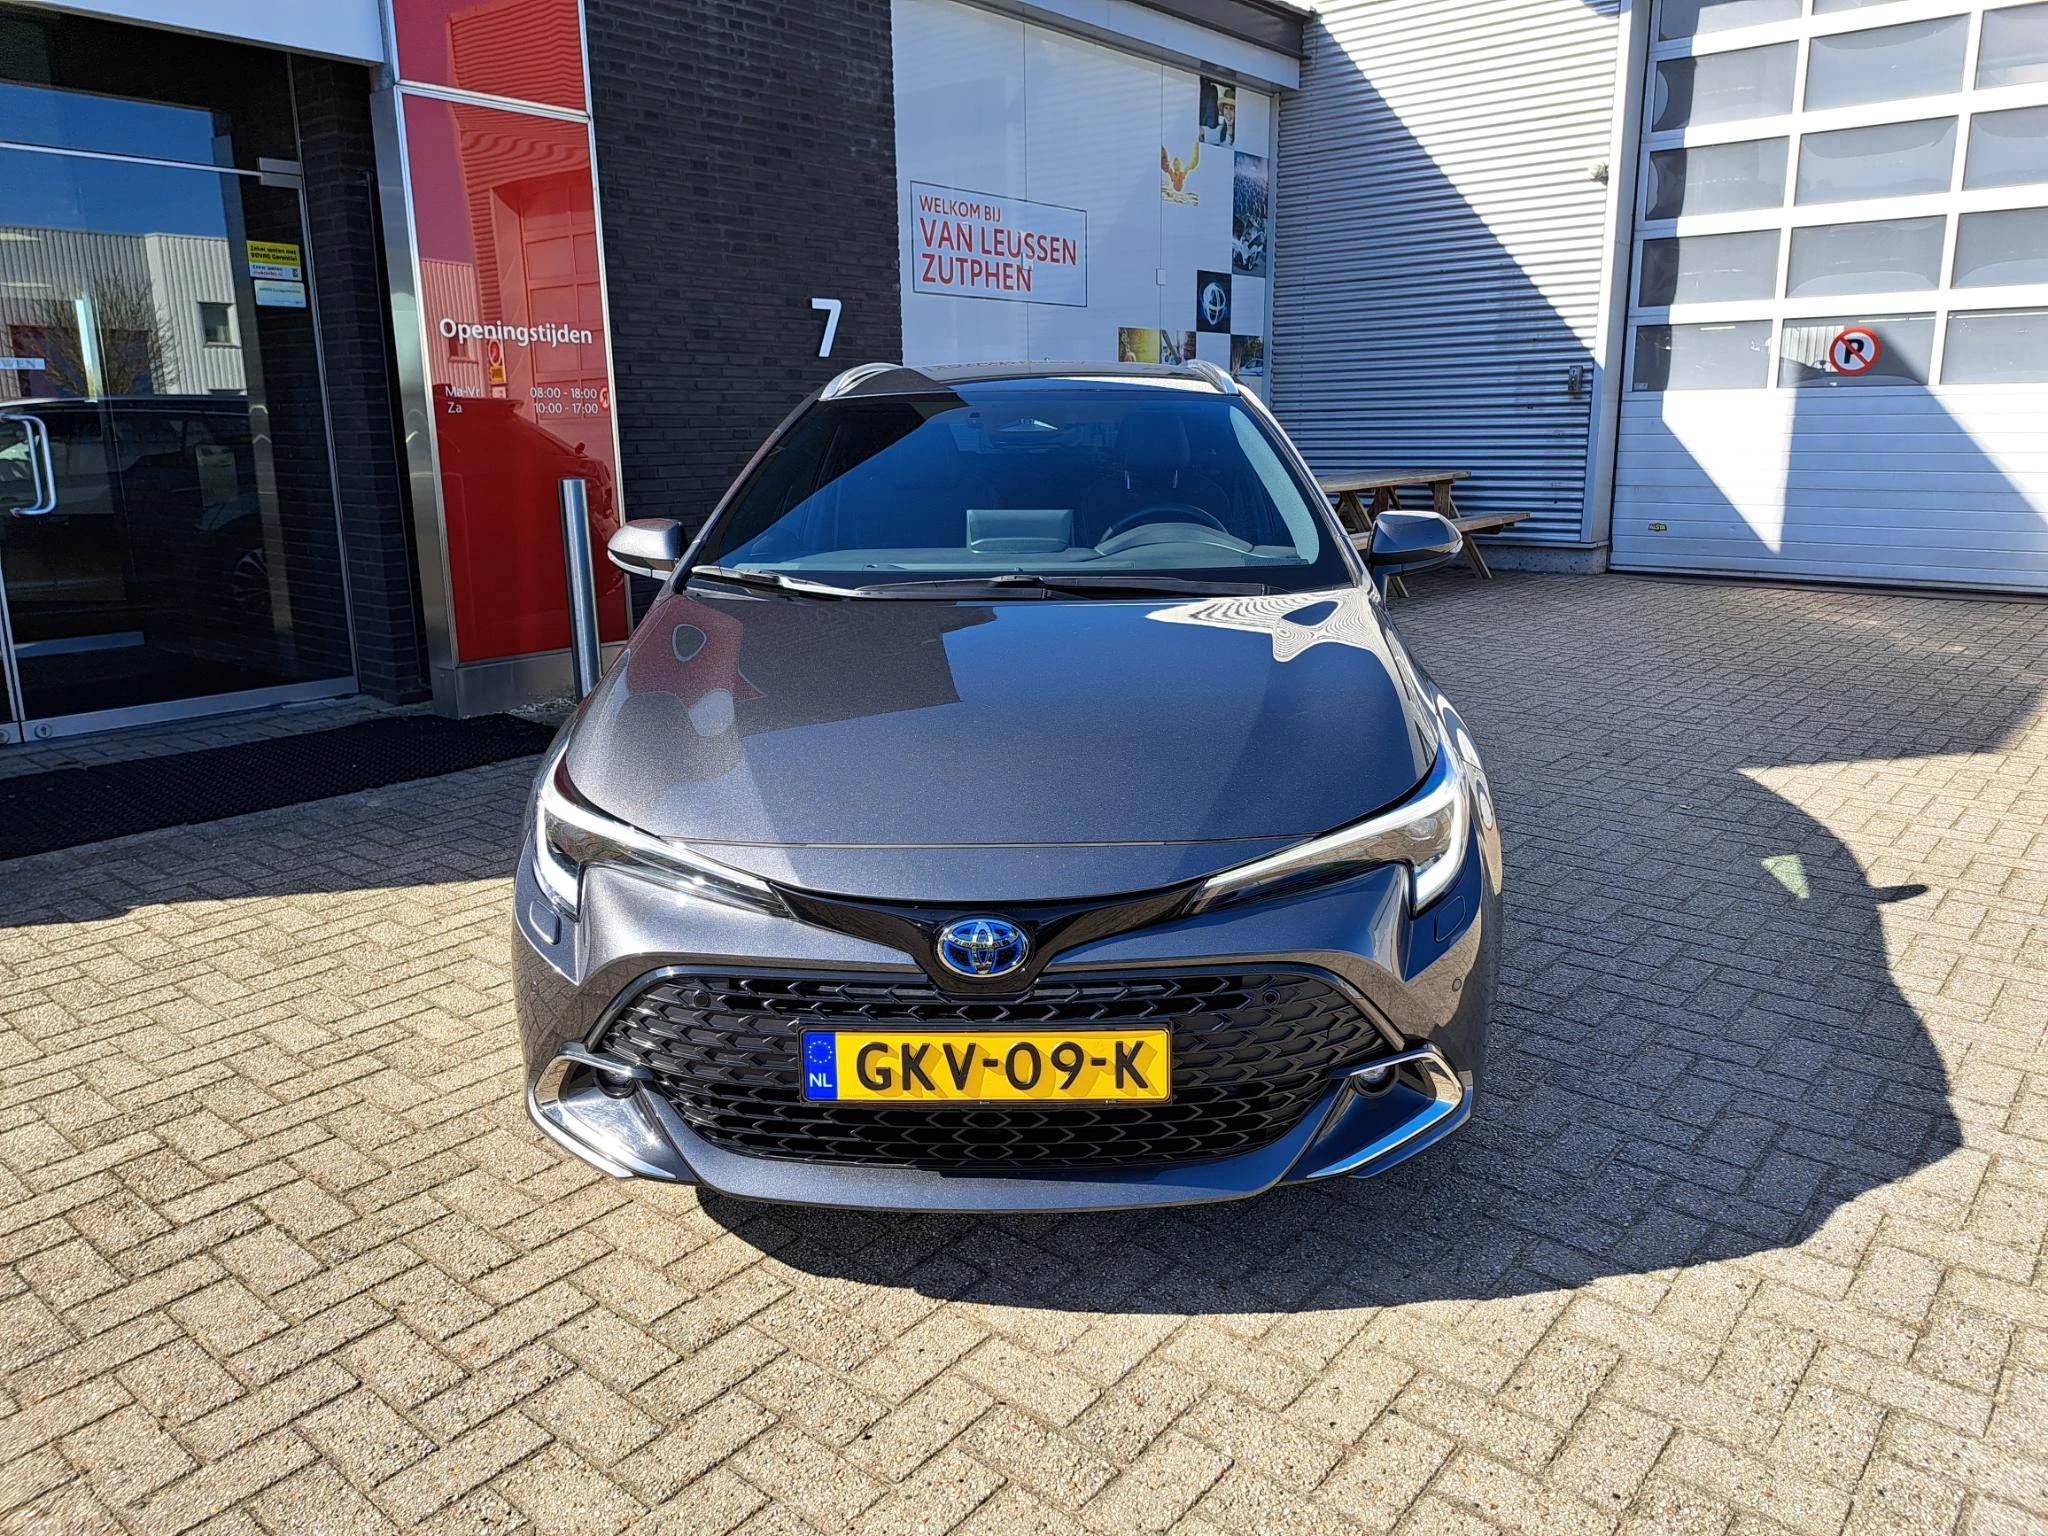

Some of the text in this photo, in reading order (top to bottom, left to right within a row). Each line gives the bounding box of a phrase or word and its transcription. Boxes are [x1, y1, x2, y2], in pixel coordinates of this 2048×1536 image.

[919, 195, 1001, 223] WELKOM BIJ
[920, 218, 1077, 266] VAN LEUSSEN
[922, 253, 1033, 292] ZUTPHEN
[439, 318, 593, 348] Openingstijden
[811, 297, 842, 357] 7
[445, 386, 481, 398] Ma-Vr
[530, 387, 561, 399] 08:00
[570, 387, 598, 399] 18:00
[447, 401, 463, 414] Za
[535, 402, 562, 414] 10:00
[572, 403, 599, 414] 17:00
[809, 1072, 832, 1088] NL
[856, 1041, 1149, 1091] GKV-09-K
